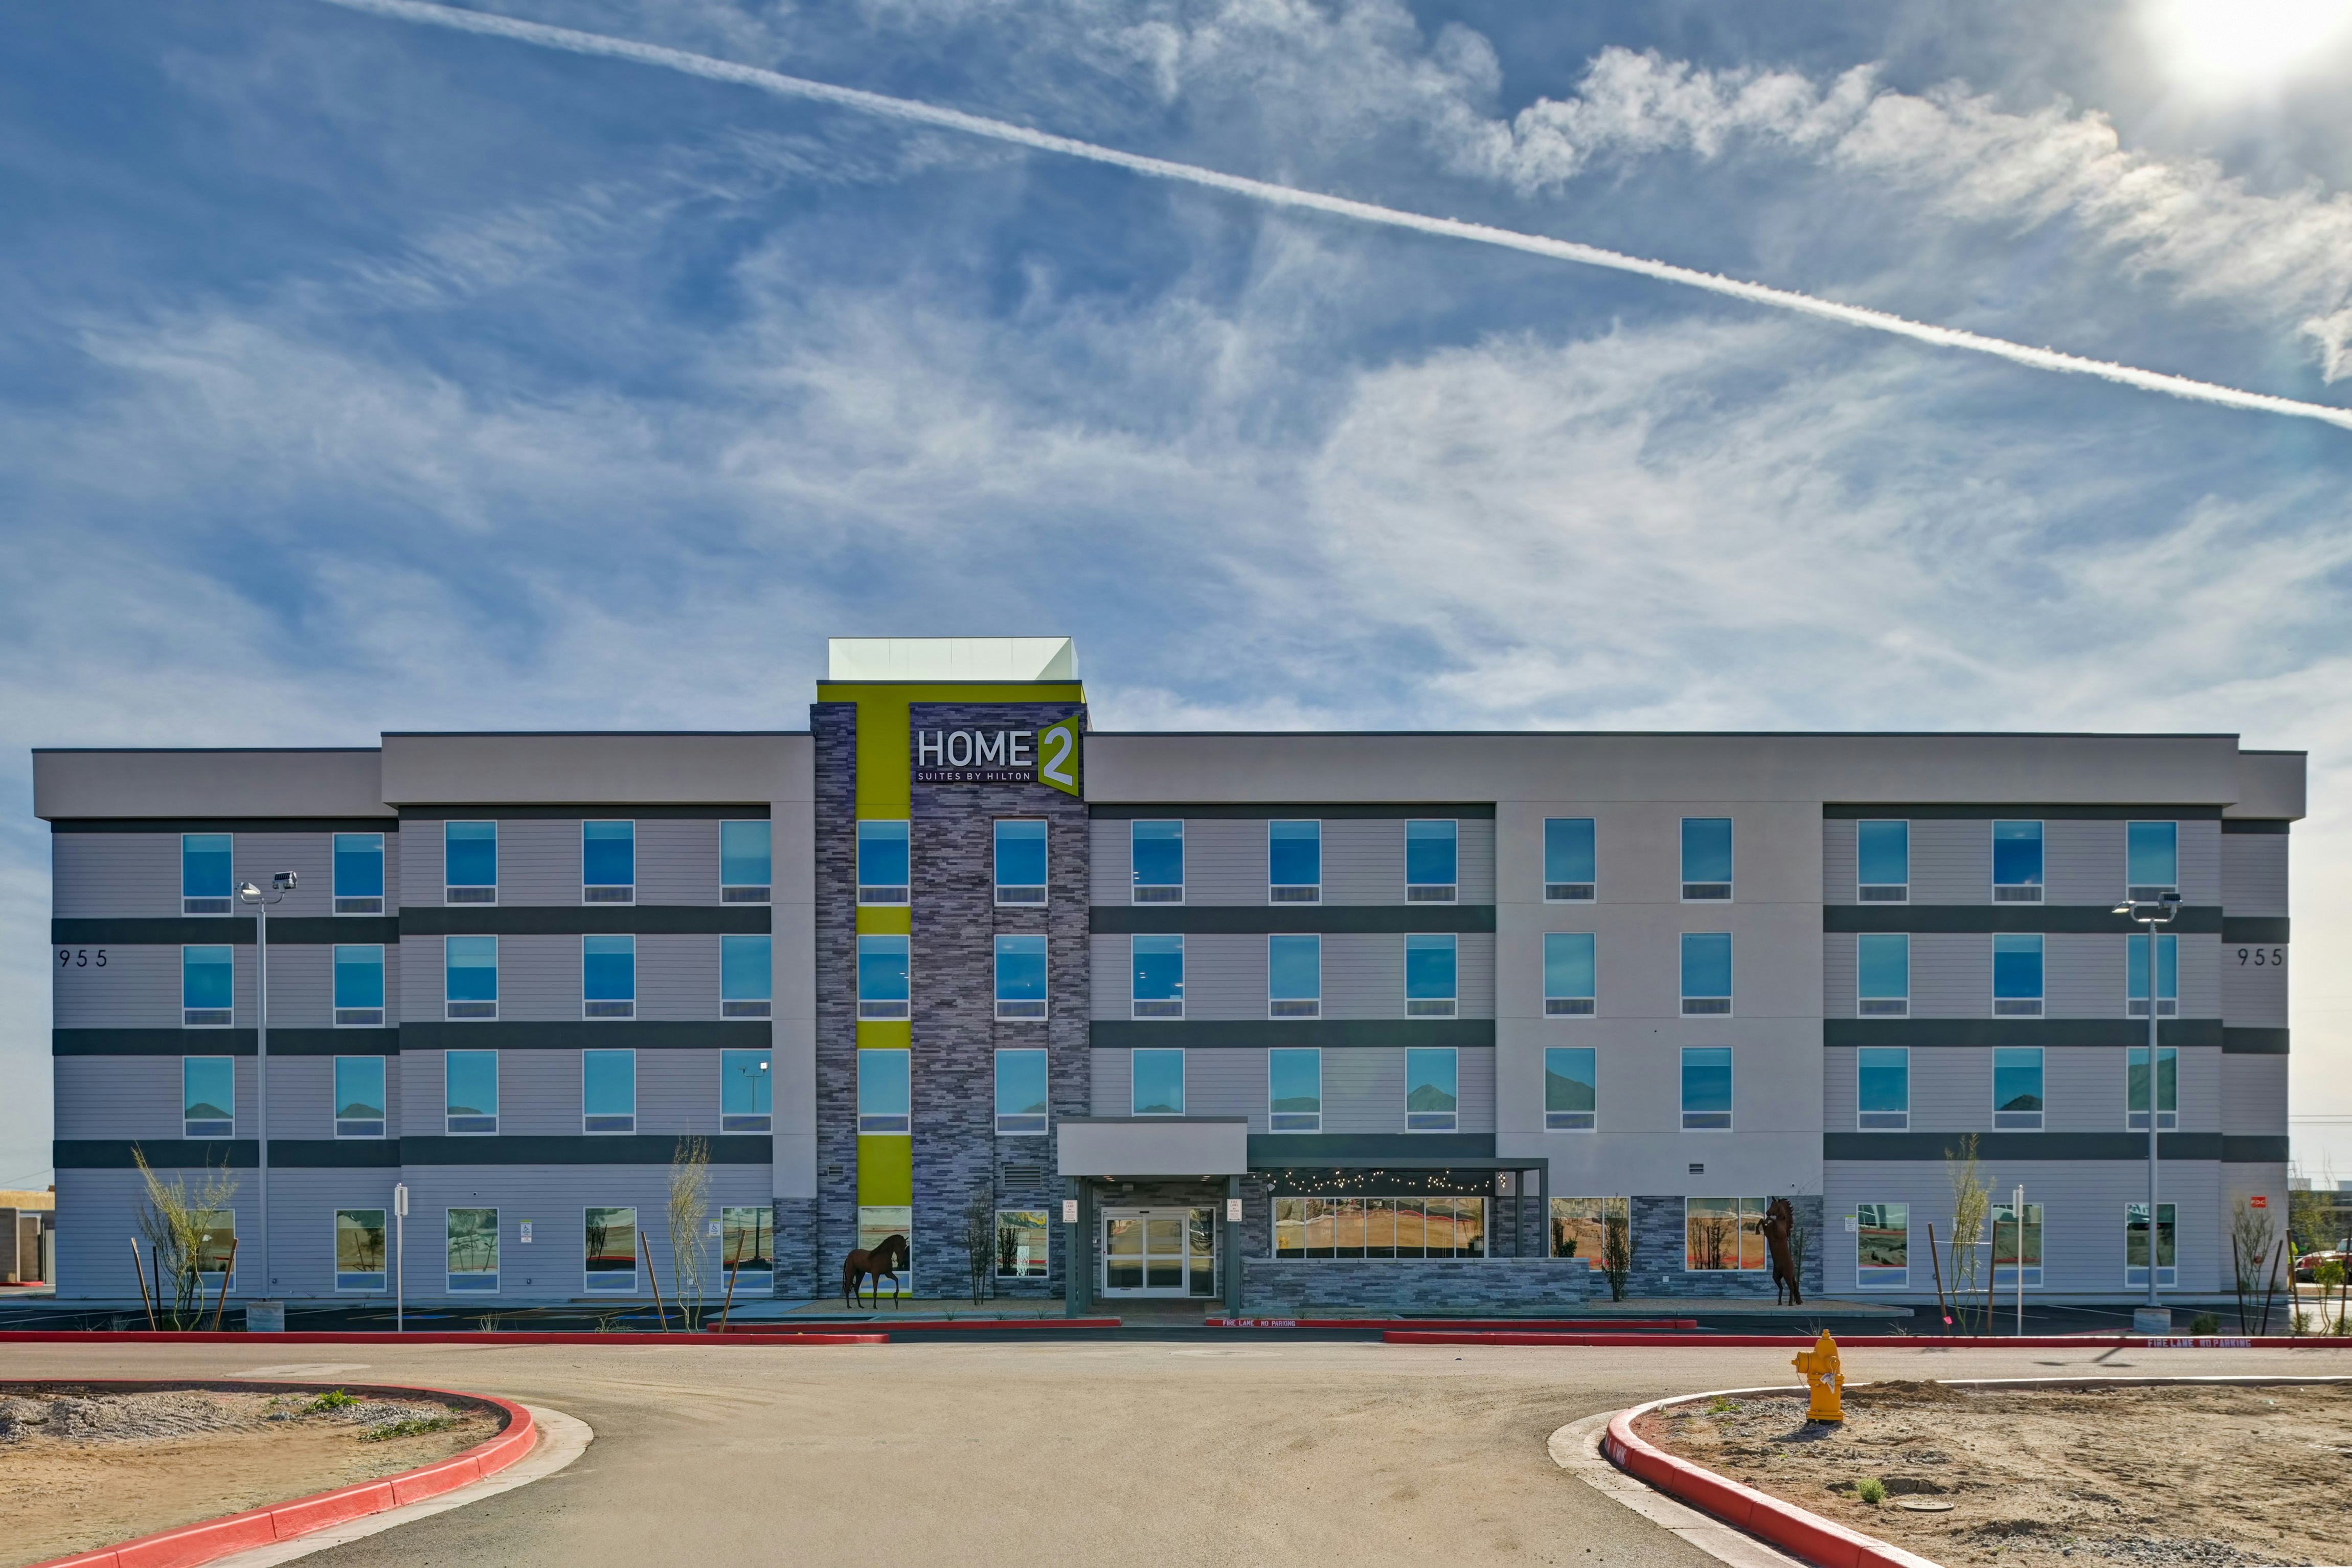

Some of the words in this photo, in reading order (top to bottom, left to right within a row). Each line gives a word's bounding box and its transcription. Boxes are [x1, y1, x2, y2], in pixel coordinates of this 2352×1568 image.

[919, 731, 1032, 766] HOME
[1044, 726, 1073, 786] 2
[60, 949, 106, 967] 955
[2238, 948, 2282, 966] 955
[2148, 1339, 2168, 1347] FIRE
[2170, 1339, 2193, 1347] LANE
[2200, 1339, 2211, 1347] NO
[2213, 1339, 2251, 1347] PARKING
